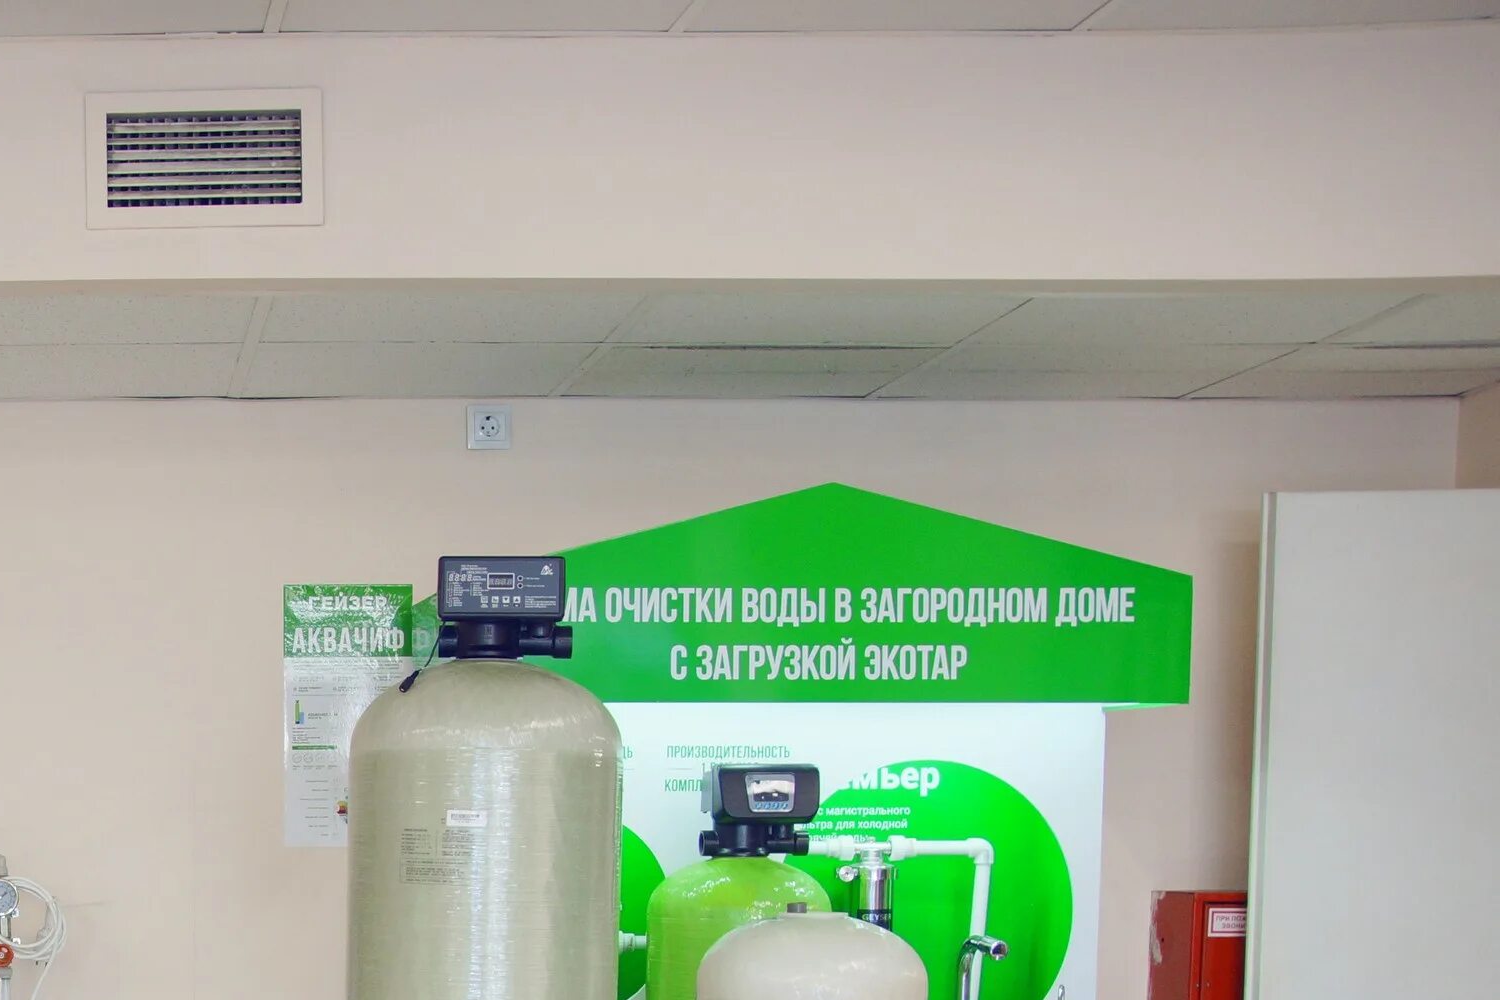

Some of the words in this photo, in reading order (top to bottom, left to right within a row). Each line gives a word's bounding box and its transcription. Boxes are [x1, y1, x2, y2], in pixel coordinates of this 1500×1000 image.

[308, 590, 387, 611] ГЕЙЗЕР
[605, 587, 732, 623] ОЧИСТКИ
[742, 587, 826, 627] ВОДЫ
[835, 587, 852, 623] В
[861, 587, 1048, 627] ЗАГОРОДНОМ
[1055, 587, 1136, 626] ДОМЕ
[292, 625, 405, 654] АКВАЧИФ
[670, 644, 687, 680] С
[696, 637, 856, 681] ЗАГРУЗКОЙ
[865, 644, 968, 681] ЭКОТАР
[666, 745, 791, 759] ПРОИЗВОДИТЕЛЬНОСТЬ
[826, 806, 911, 818] магистрального
[835, 821, 856, 831] для
[858, 819, 908, 832] холодной
